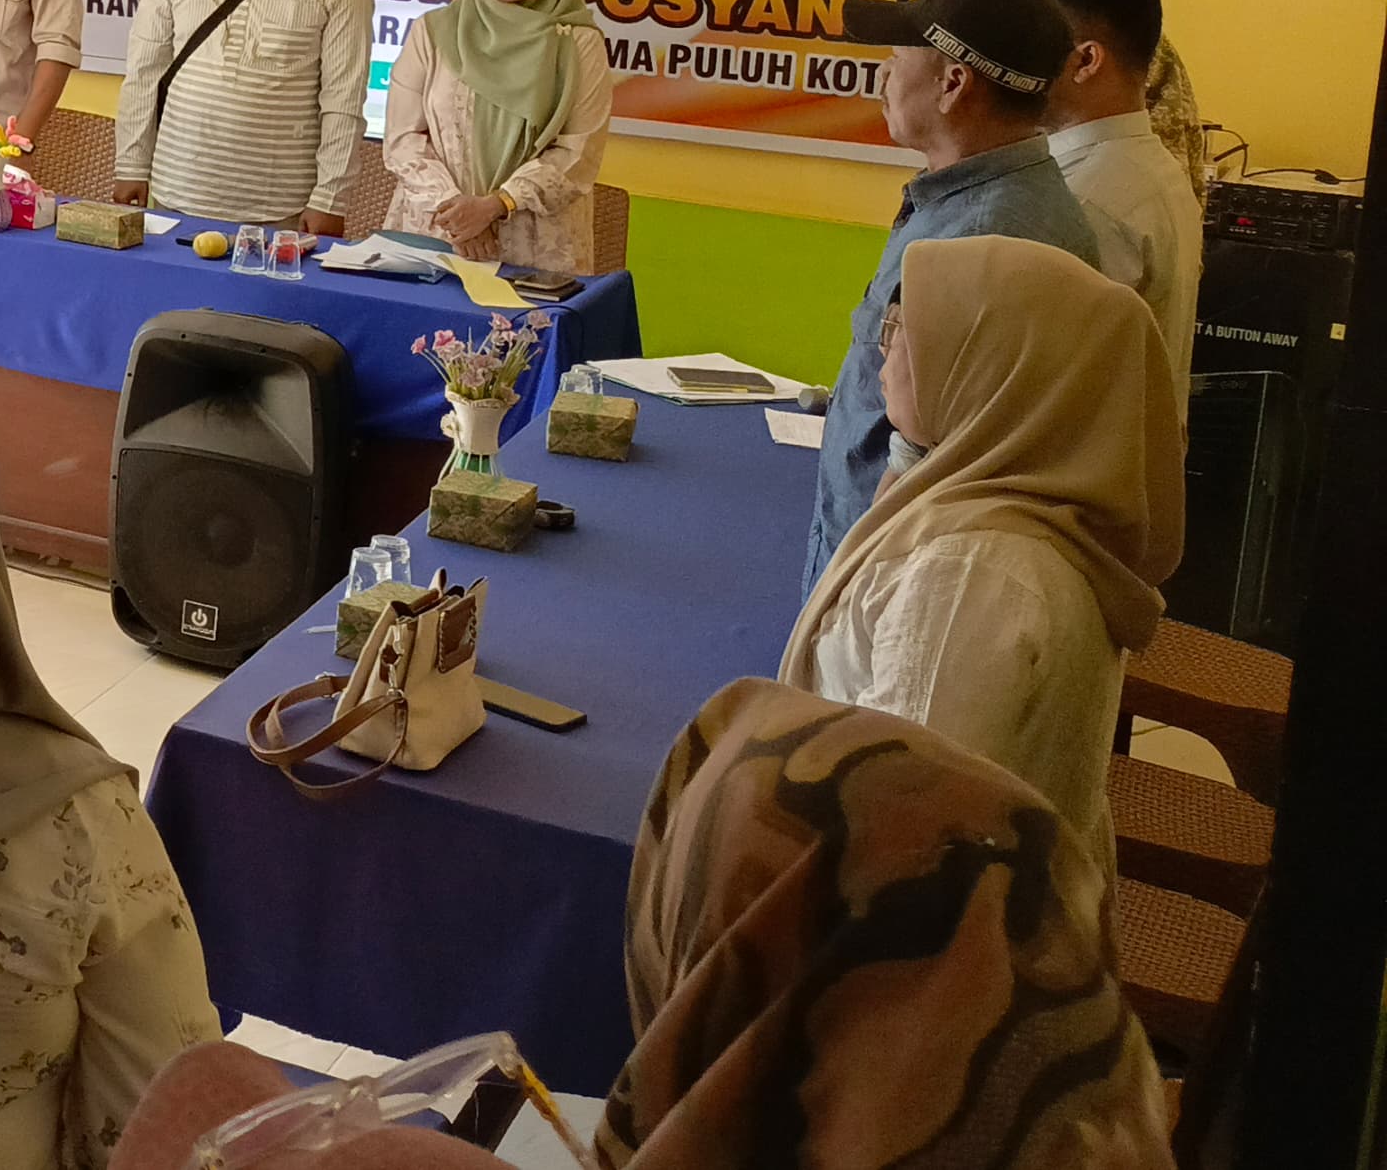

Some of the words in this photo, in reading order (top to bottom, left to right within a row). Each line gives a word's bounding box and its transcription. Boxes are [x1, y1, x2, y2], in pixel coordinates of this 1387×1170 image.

[604, 37, 653, 72] MA
[668, 43, 793, 86] PULUH
[807, 57, 882, 95] KOT
[930, 29, 965, 57] PUMA
[965, 51, 1003, 79] PUMA
[1204, 324, 1213, 336] A
[1215, 325, 1261, 342] BUTTON
[1262, 332, 1299, 347] AWAY
